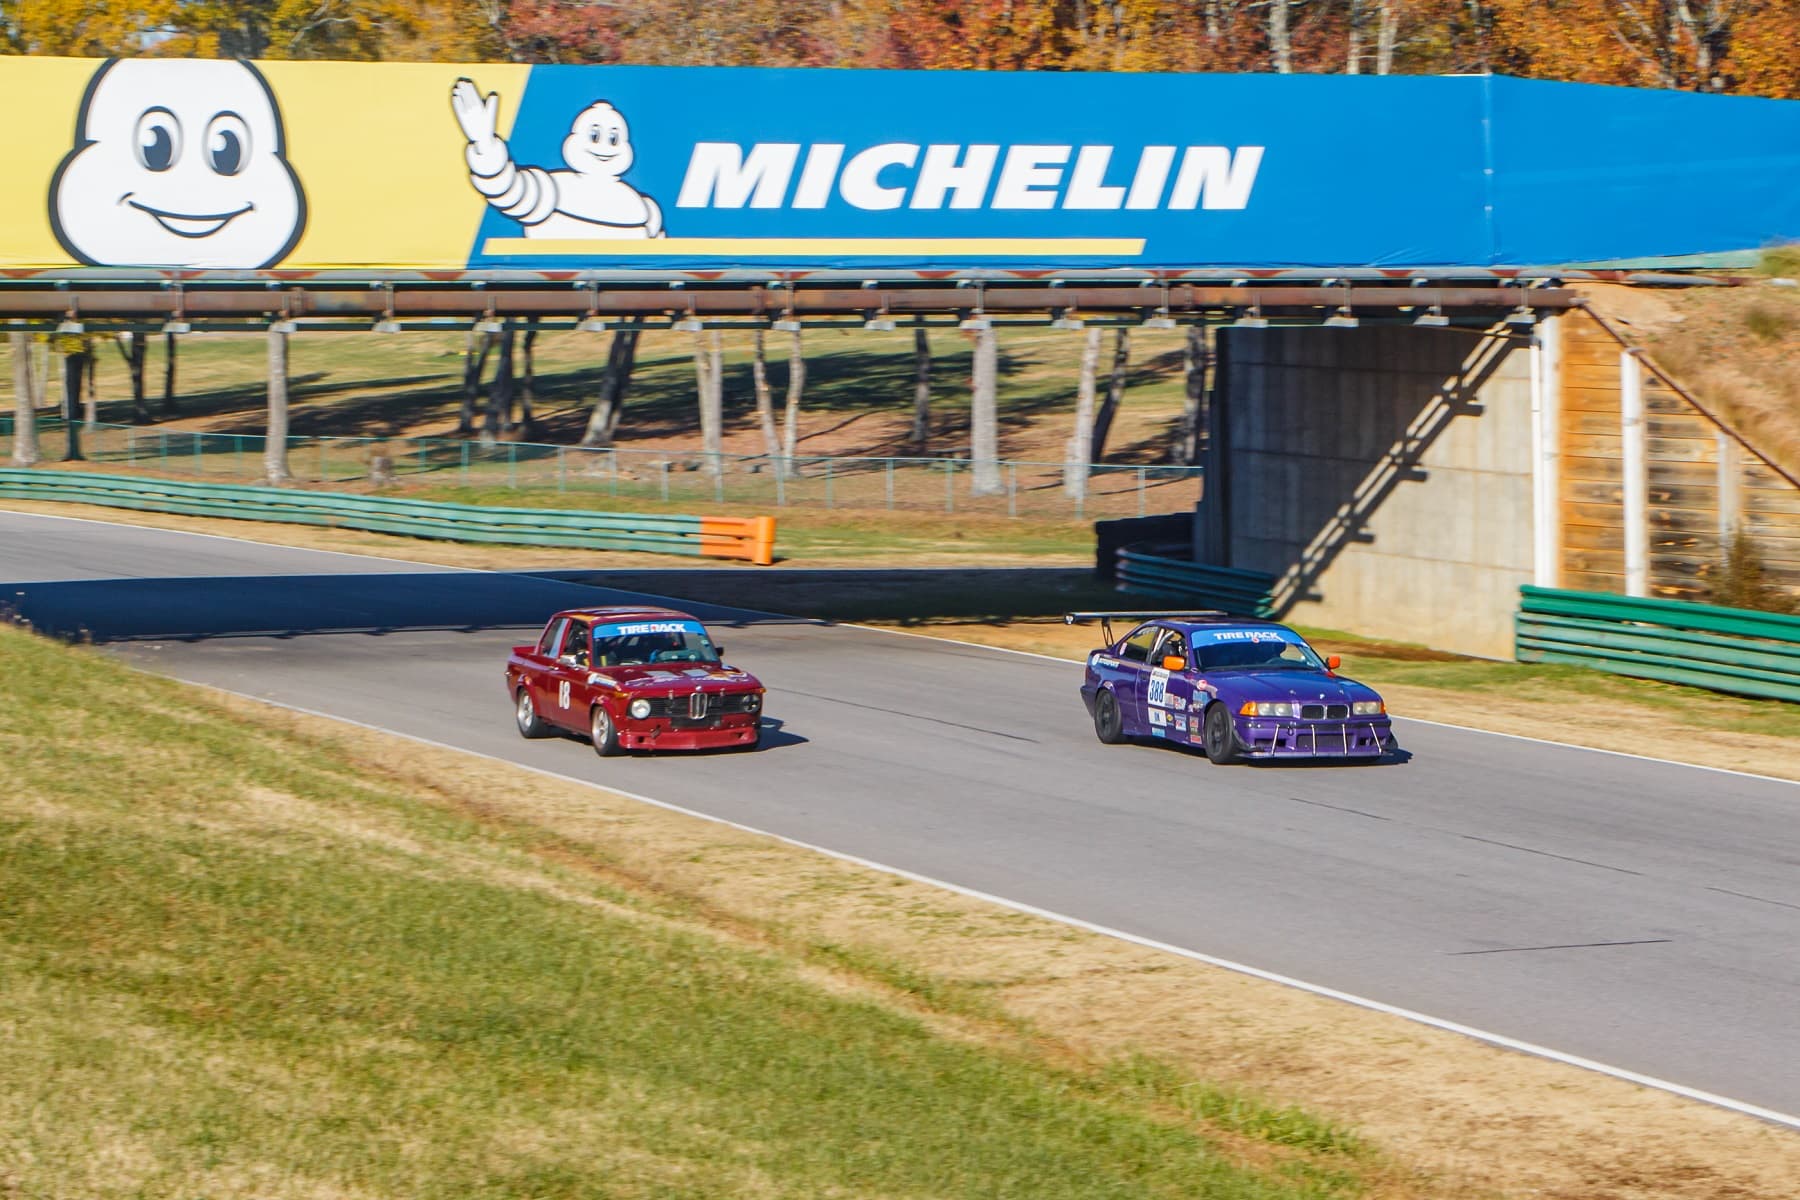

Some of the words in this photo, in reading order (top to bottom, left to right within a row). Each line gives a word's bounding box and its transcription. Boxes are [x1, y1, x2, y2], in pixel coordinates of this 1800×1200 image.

[676, 142, 1265, 210] MICHELIN
[617, 624, 651, 635] TIRE
[651, 623, 687, 633] RACK
[1213, 631, 1245, 641] TIRE
[1245, 631, 1283, 641] RACK
[558, 680, 571, 710] 18
[1149, 679, 1165, 703] 388
